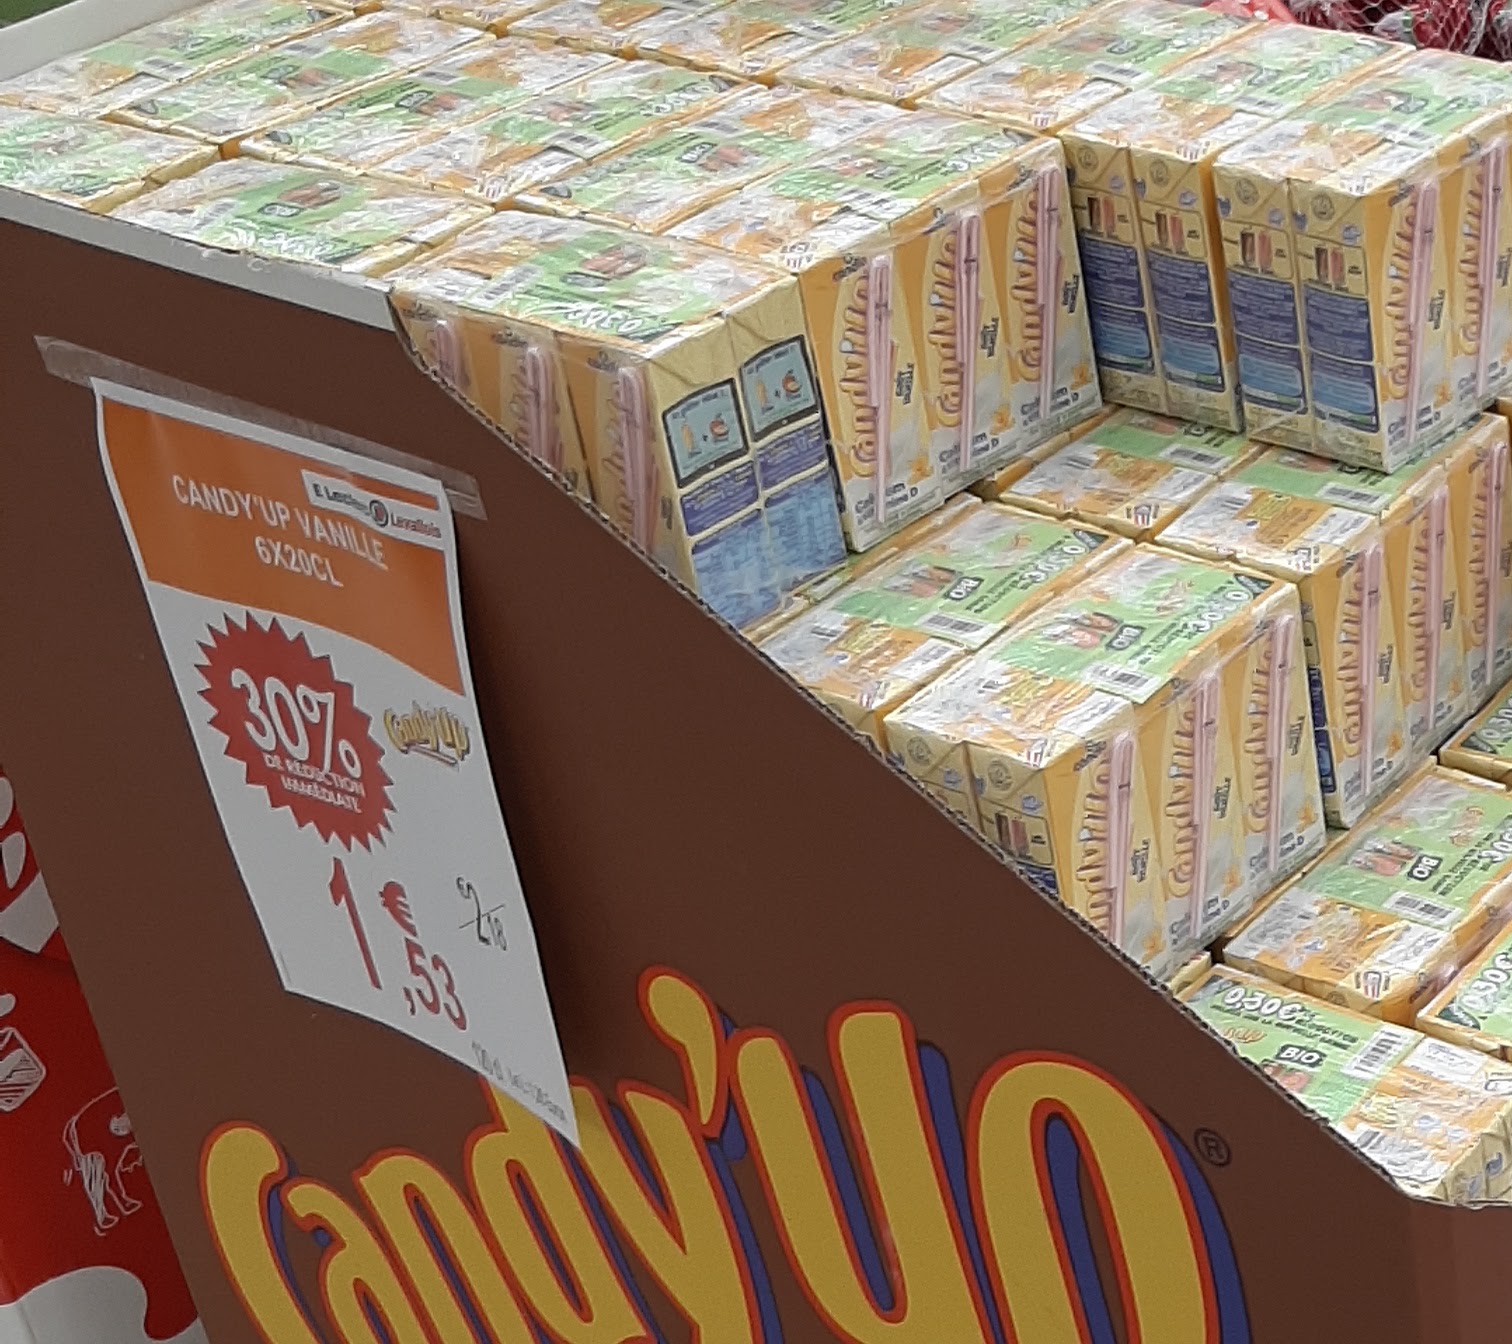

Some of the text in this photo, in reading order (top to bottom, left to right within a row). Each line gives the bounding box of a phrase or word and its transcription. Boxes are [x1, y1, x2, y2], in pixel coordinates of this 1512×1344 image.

[171, 475, 389, 571] CANDY'UP VANILLE
[255, 536, 344, 587] 6X20CL
[230, 668, 362, 778] 30%
[1280, 1046, 1322, 1065] BIO
